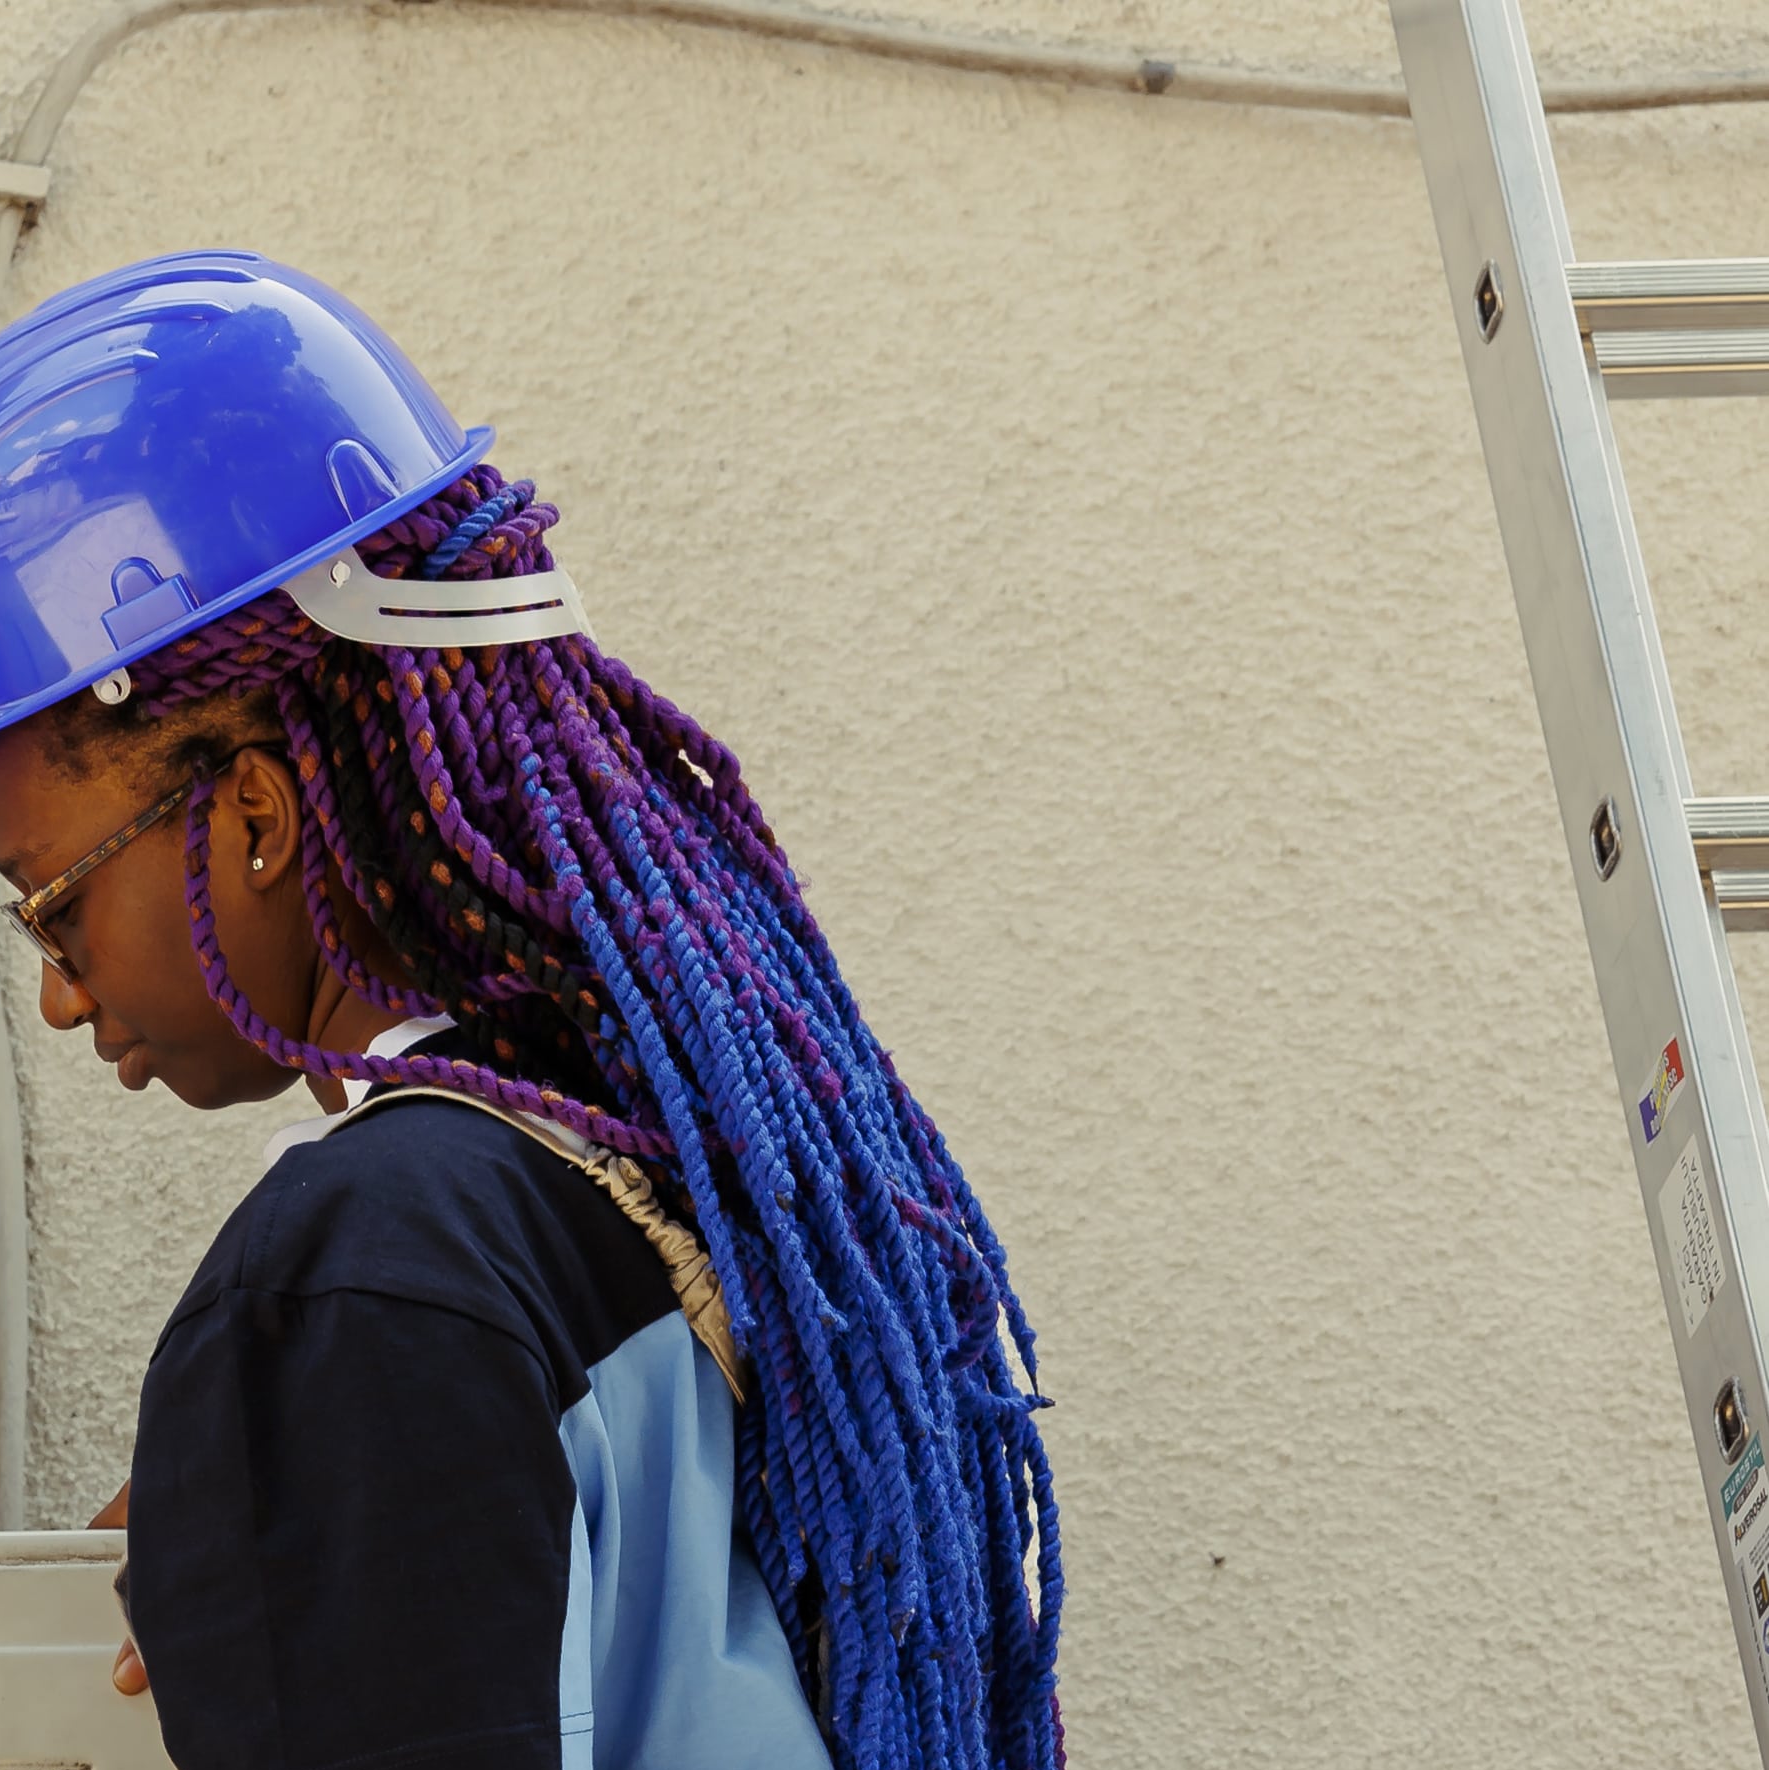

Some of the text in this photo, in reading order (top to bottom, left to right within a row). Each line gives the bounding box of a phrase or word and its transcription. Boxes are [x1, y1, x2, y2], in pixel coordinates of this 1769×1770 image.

[1682, 1244, 1696, 1284] AICI
[1712, 1260, 1721, 1283] IN
[1723, 1443, 1761, 1503] EUROSTIL
